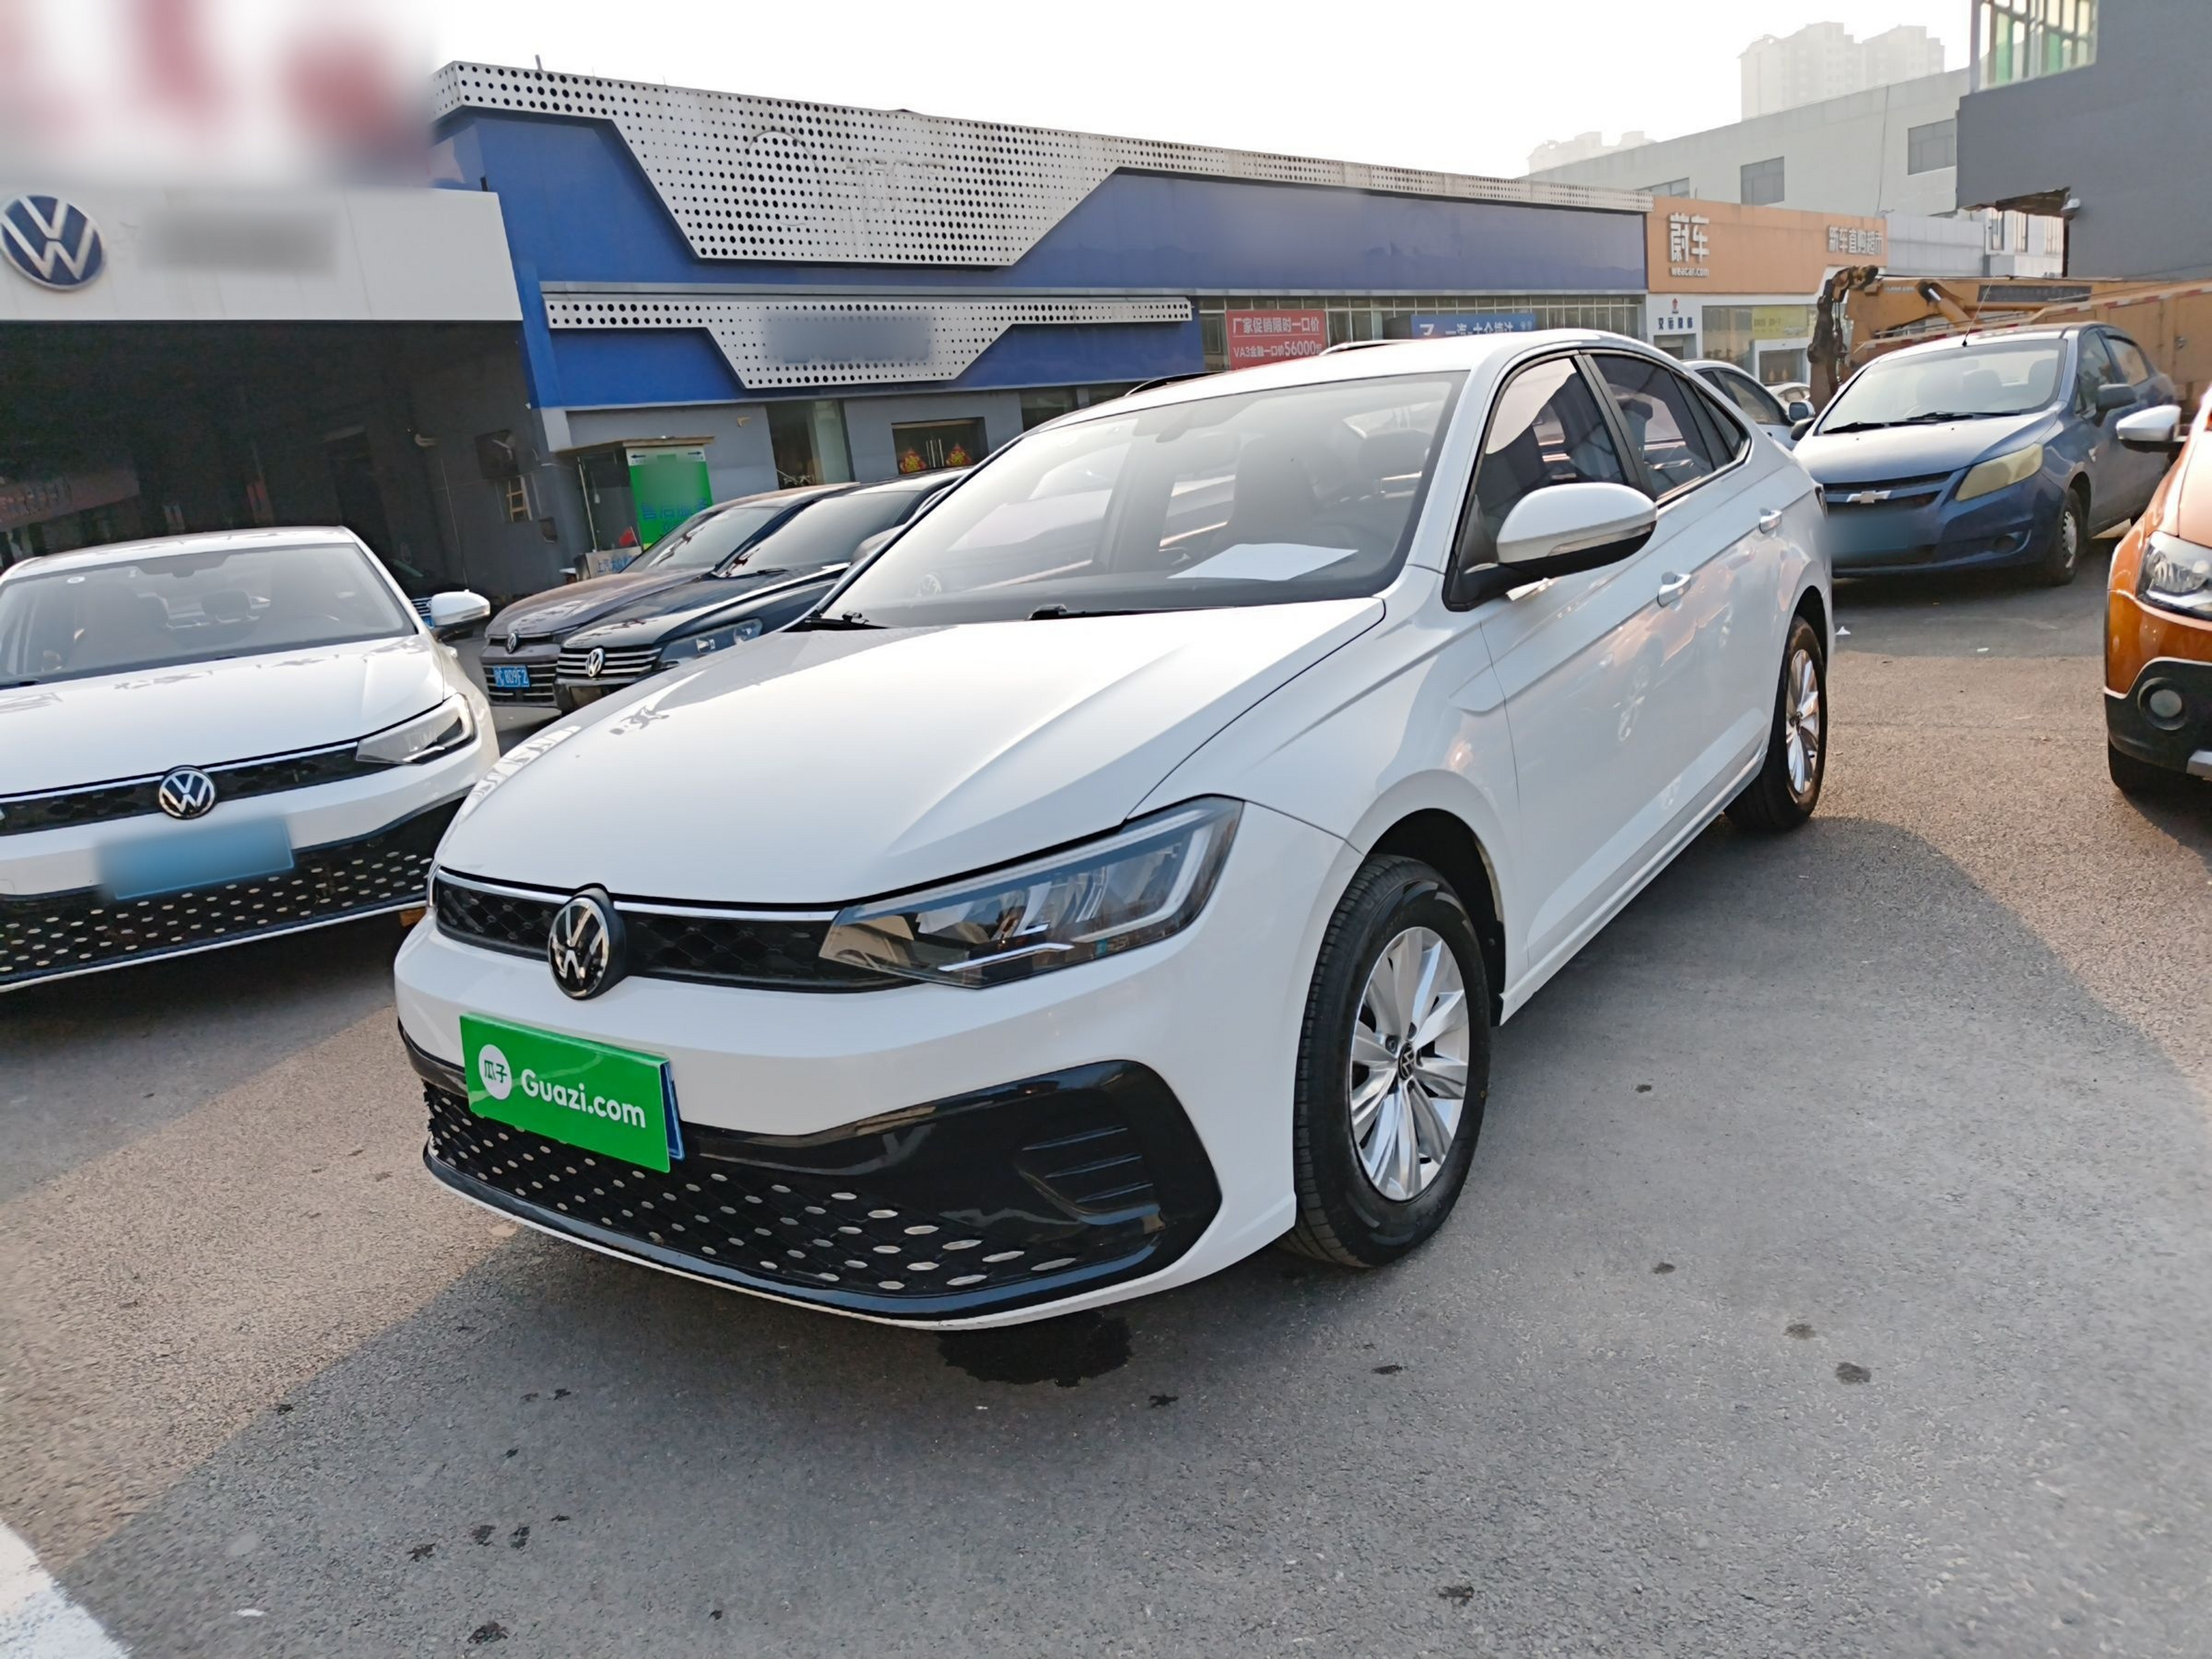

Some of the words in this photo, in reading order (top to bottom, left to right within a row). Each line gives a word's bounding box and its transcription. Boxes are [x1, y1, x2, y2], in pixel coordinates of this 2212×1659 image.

[1233, 317, 1319, 334] 厂家促销限时一口价
[484, 1059, 507, 1084] 瓜子
[520, 1068, 646, 1128] Guazi.com
